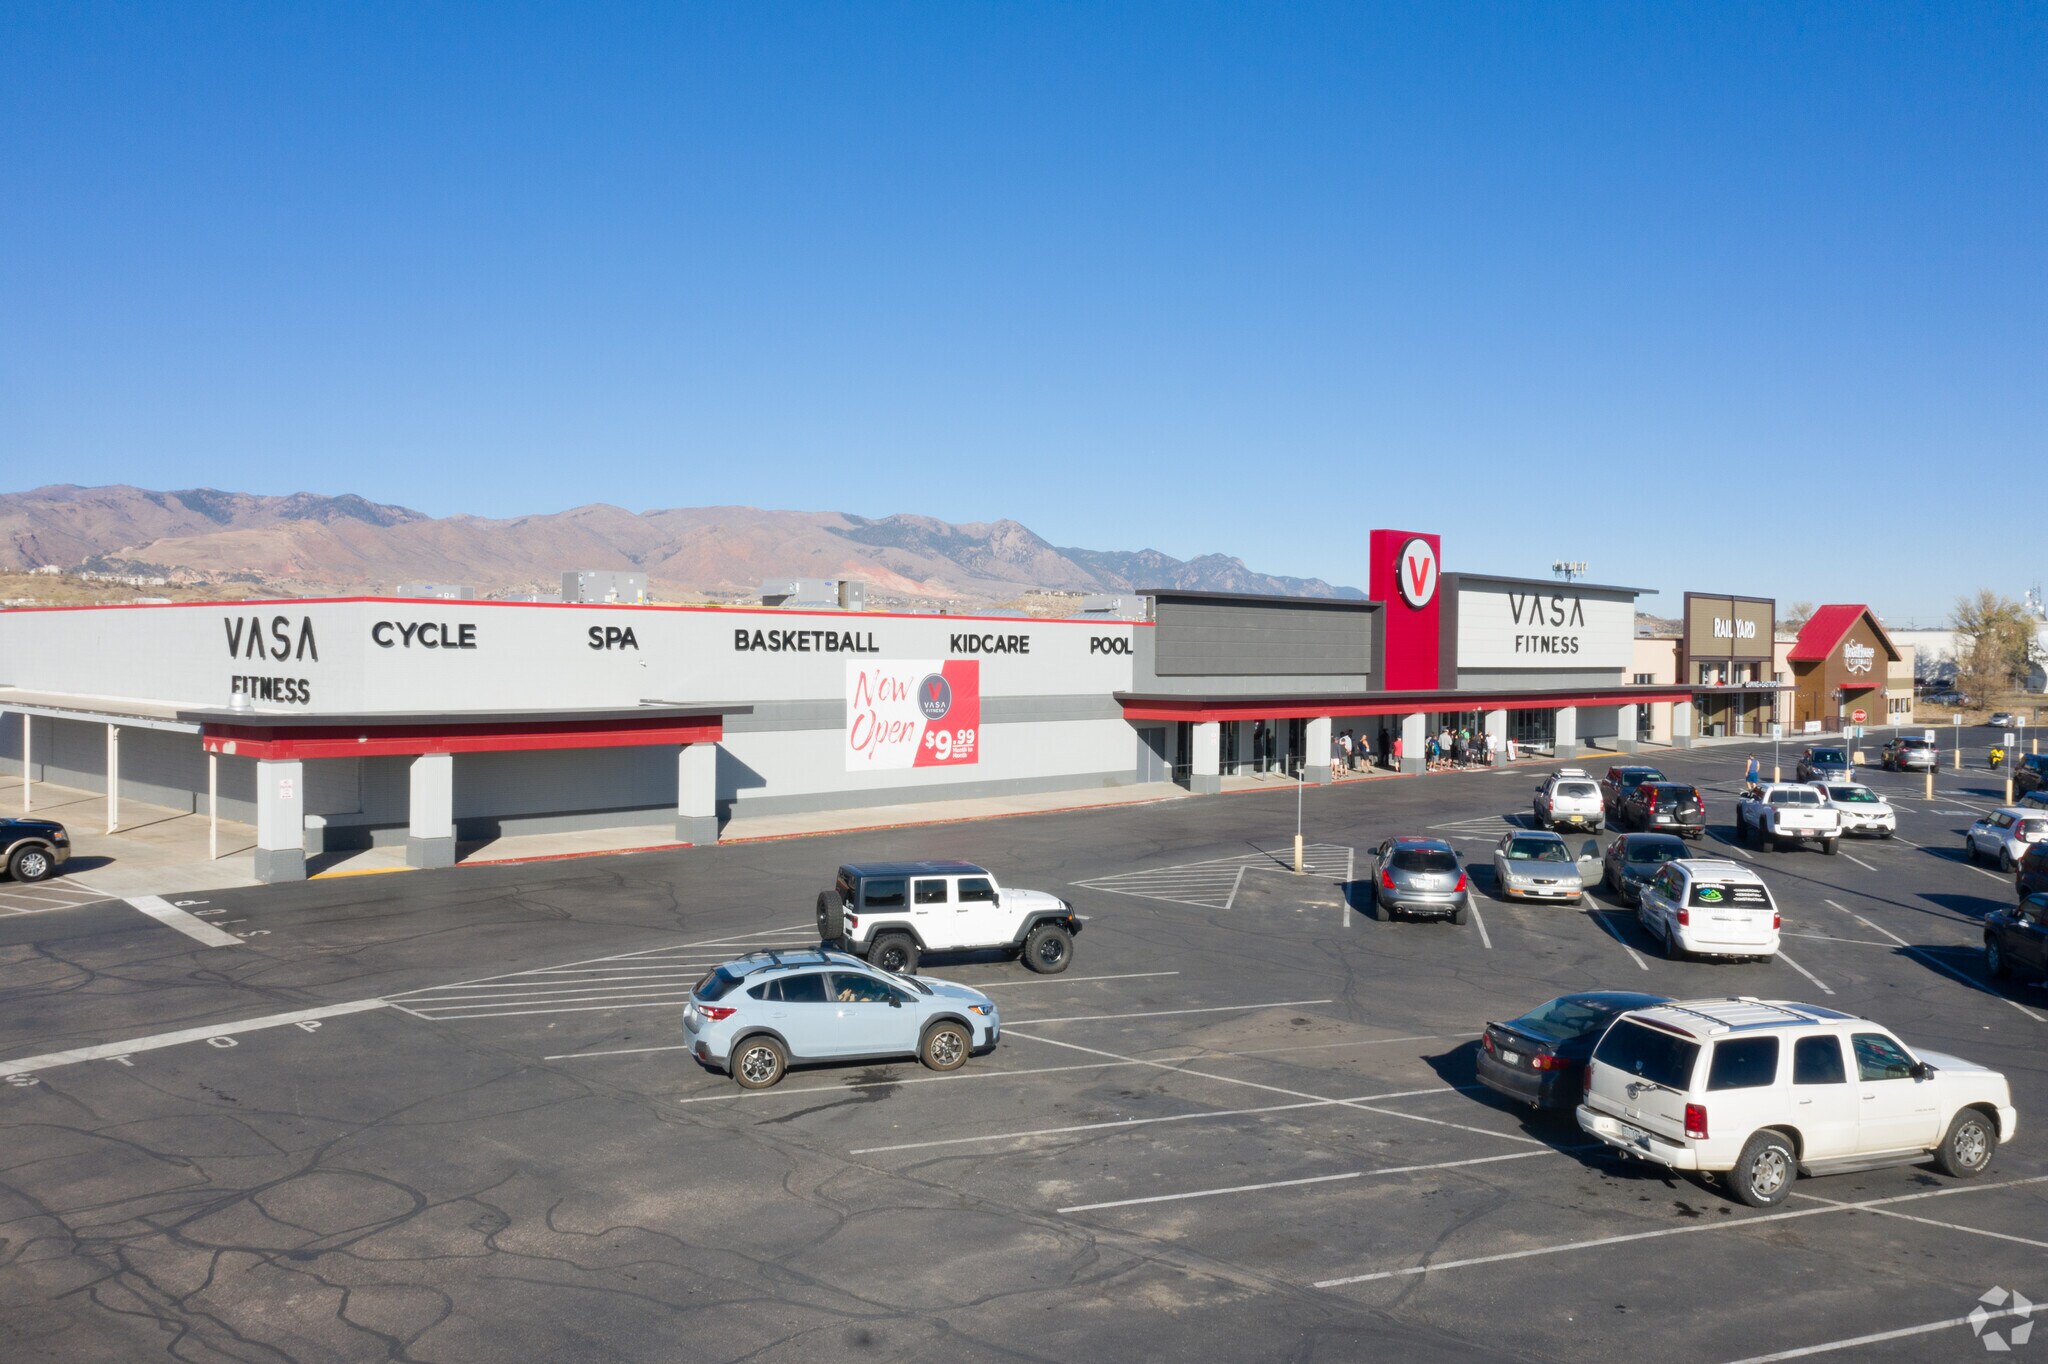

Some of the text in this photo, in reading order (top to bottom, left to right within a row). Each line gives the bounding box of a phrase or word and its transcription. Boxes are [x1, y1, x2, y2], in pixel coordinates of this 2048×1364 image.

[1407, 555, 1430, 597] V
[1508, 592, 1585, 627] VASA
[223, 615, 319, 662] VASA
[371, 620, 478, 650] CYCLE
[588, 626, 640, 651] SPA
[734, 629, 880, 653] BASKETBALL
[1714, 618, 1756, 639] RAIL YARD
[950, 633, 1030, 654] KIDCARE
[1090, 637, 1134, 655] POOL
[1515, 635, 1579, 654] FITNESS
[231, 675, 311, 705] FITNESS
[854, 669, 914, 709] Now
[923, 701, 946, 709] VASA
[851, 709, 914, 761] Open
